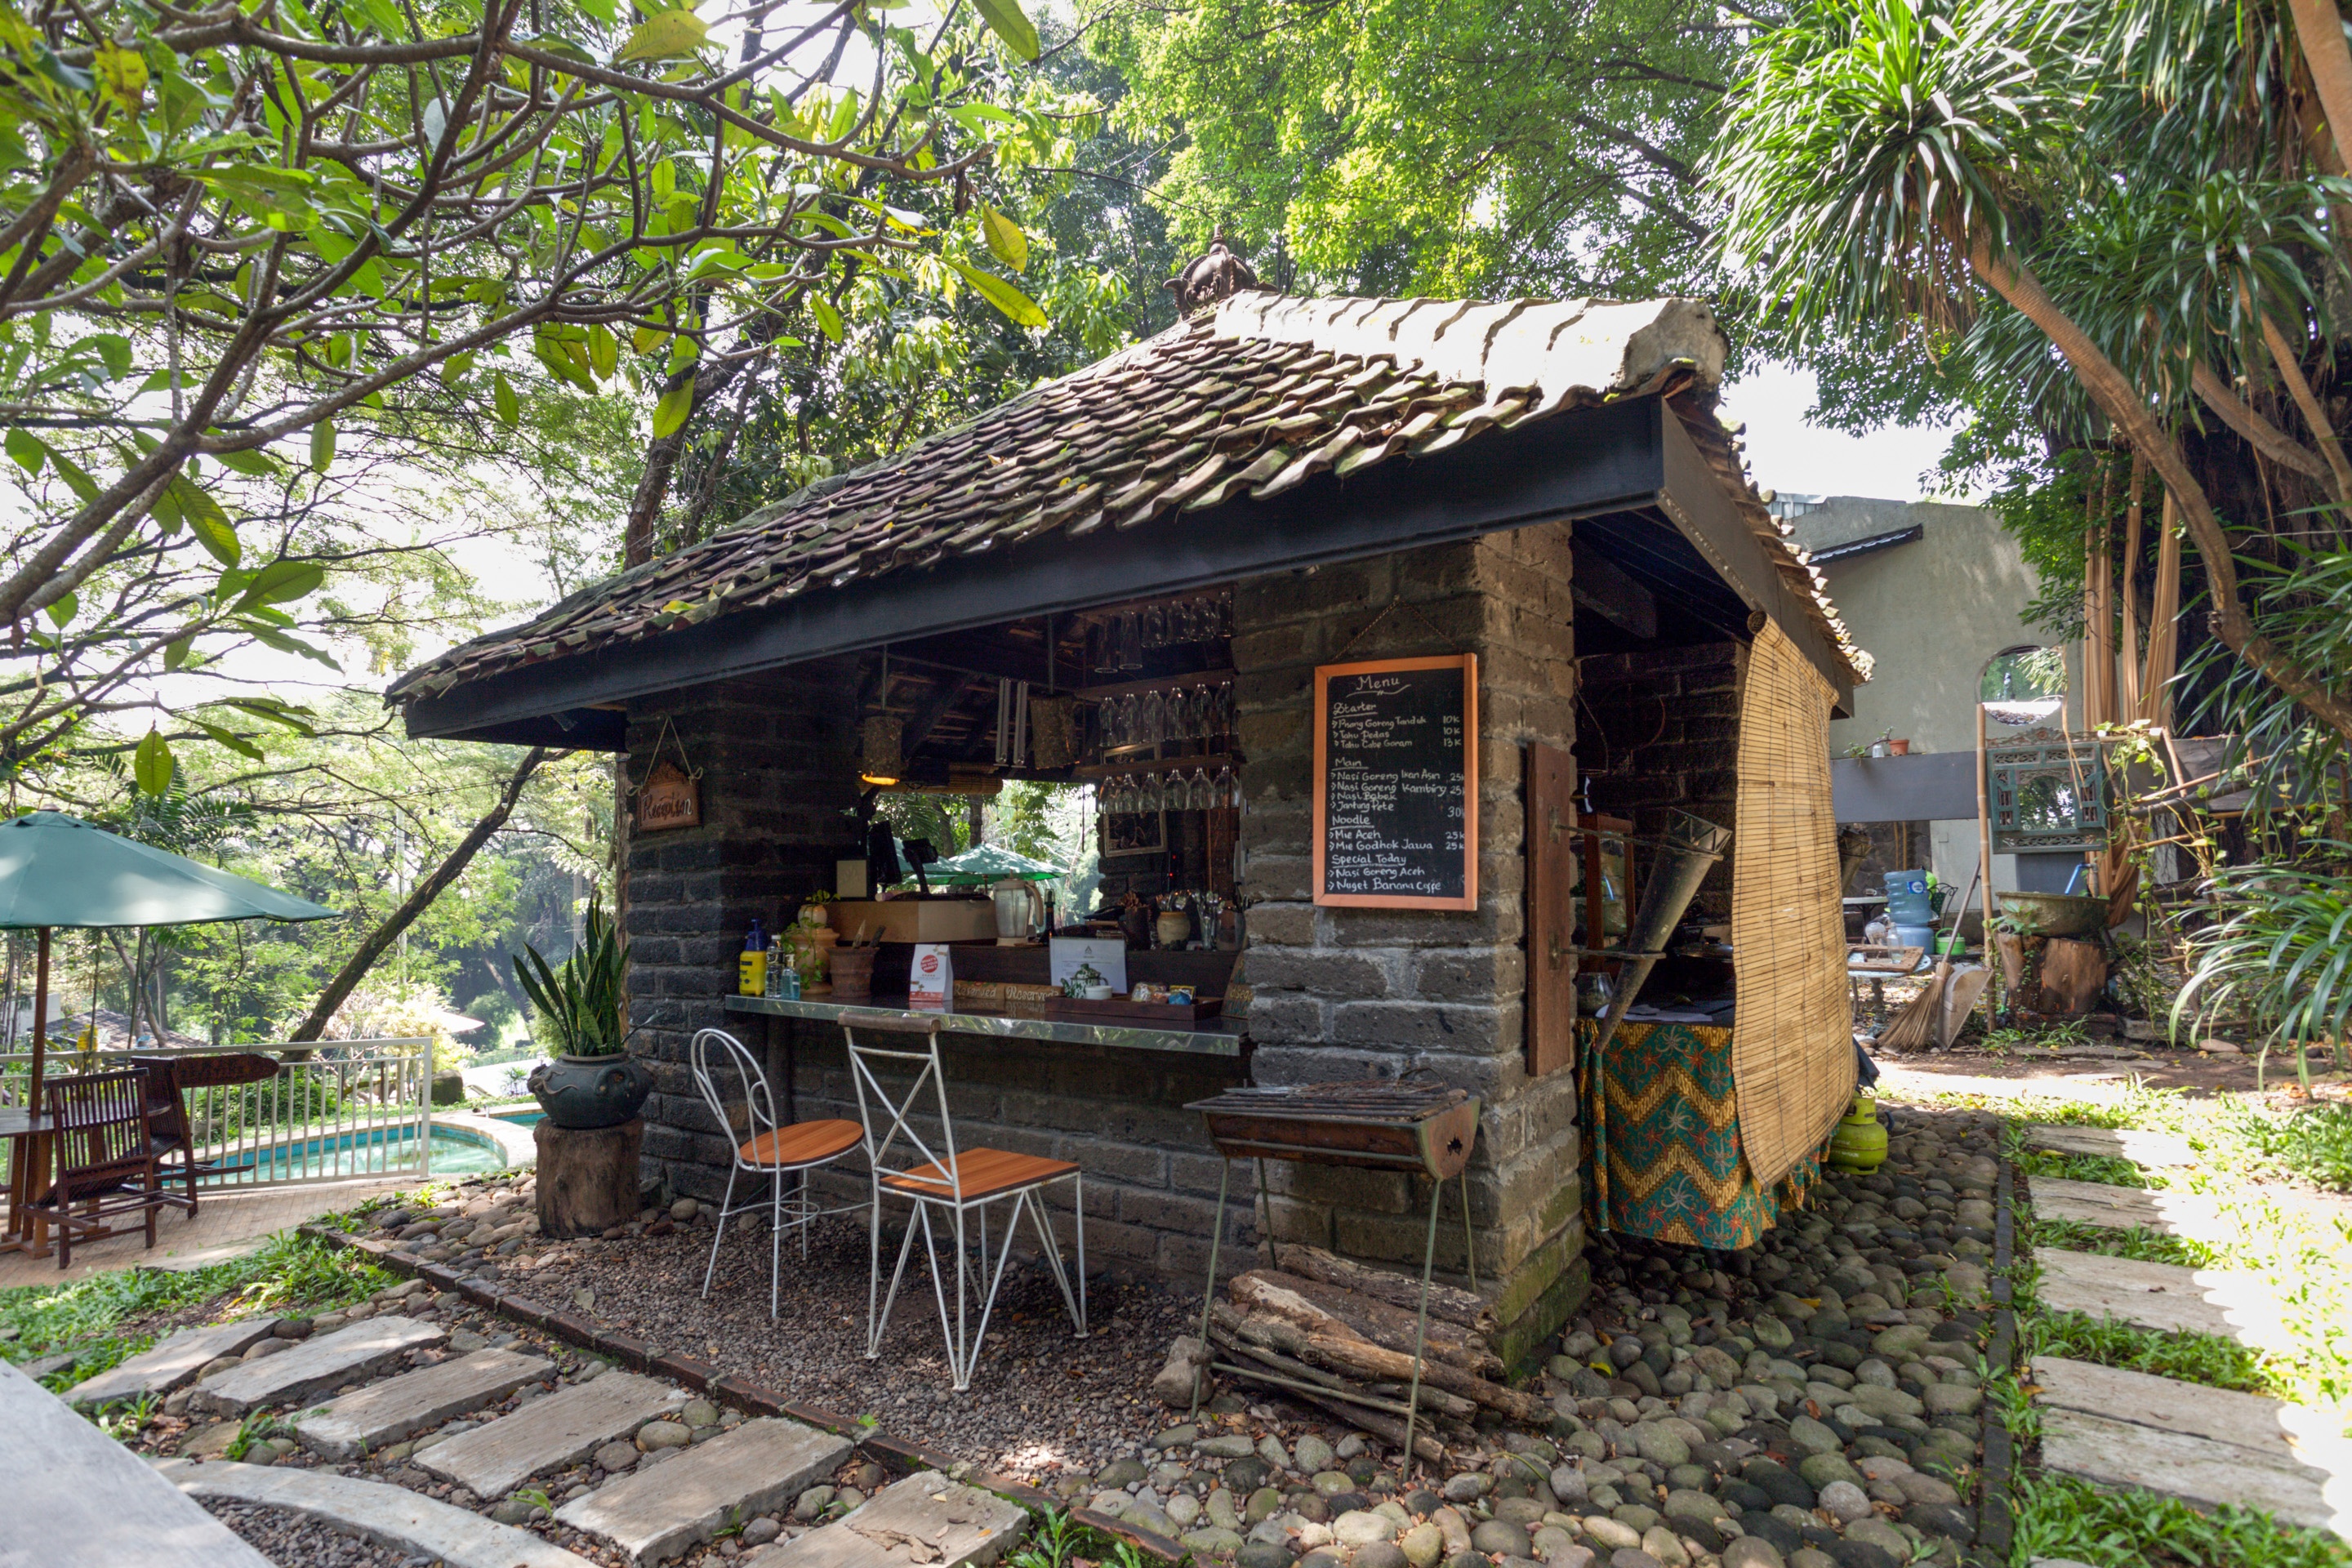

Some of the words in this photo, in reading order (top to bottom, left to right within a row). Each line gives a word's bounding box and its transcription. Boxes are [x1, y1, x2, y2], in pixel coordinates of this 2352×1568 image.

[1356, 675, 1400, 691] Menu
[1333, 702, 1377, 715] Starter
[1365, 719, 1395, 730] Goreng
[1339, 729, 1359, 739] Tahu
[1361, 729, 1390, 740] Pedas
[1340, 740, 1360, 748] Tahu
[1334, 756, 1362, 767] Main
[1337, 771, 1360, 781] Nasi
[1361, 772, 1399, 784] Goreng
[1421, 768, 1441, 780] Asin
[1337, 781, 1359, 792] Nasi
[1361, 782, 1396, 794] Goreng
[1337, 791, 1362, 800] Nasi
[1332, 814, 1371, 826] Noodle
[1334, 829, 1352, 840] Mie
[1356, 829, 1382, 840] Aceh
[1335, 841, 1353, 851] Mie
[1356, 840, 1399, 851] Godhok
[1401, 838, 1433, 849] Jawa
[1331, 853, 1372, 866] Special
[1375, 853, 1406, 866] Today
[1335, 868, 1360, 878] Nasi
[1363, 867, 1398, 880] Goreng
[1399, 866, 1425, 876] Aceh
[1336, 878, 1369, 892] Nuget
[1372, 877, 1414, 890] Banana
[954, 984, 997, 997] Reserved
